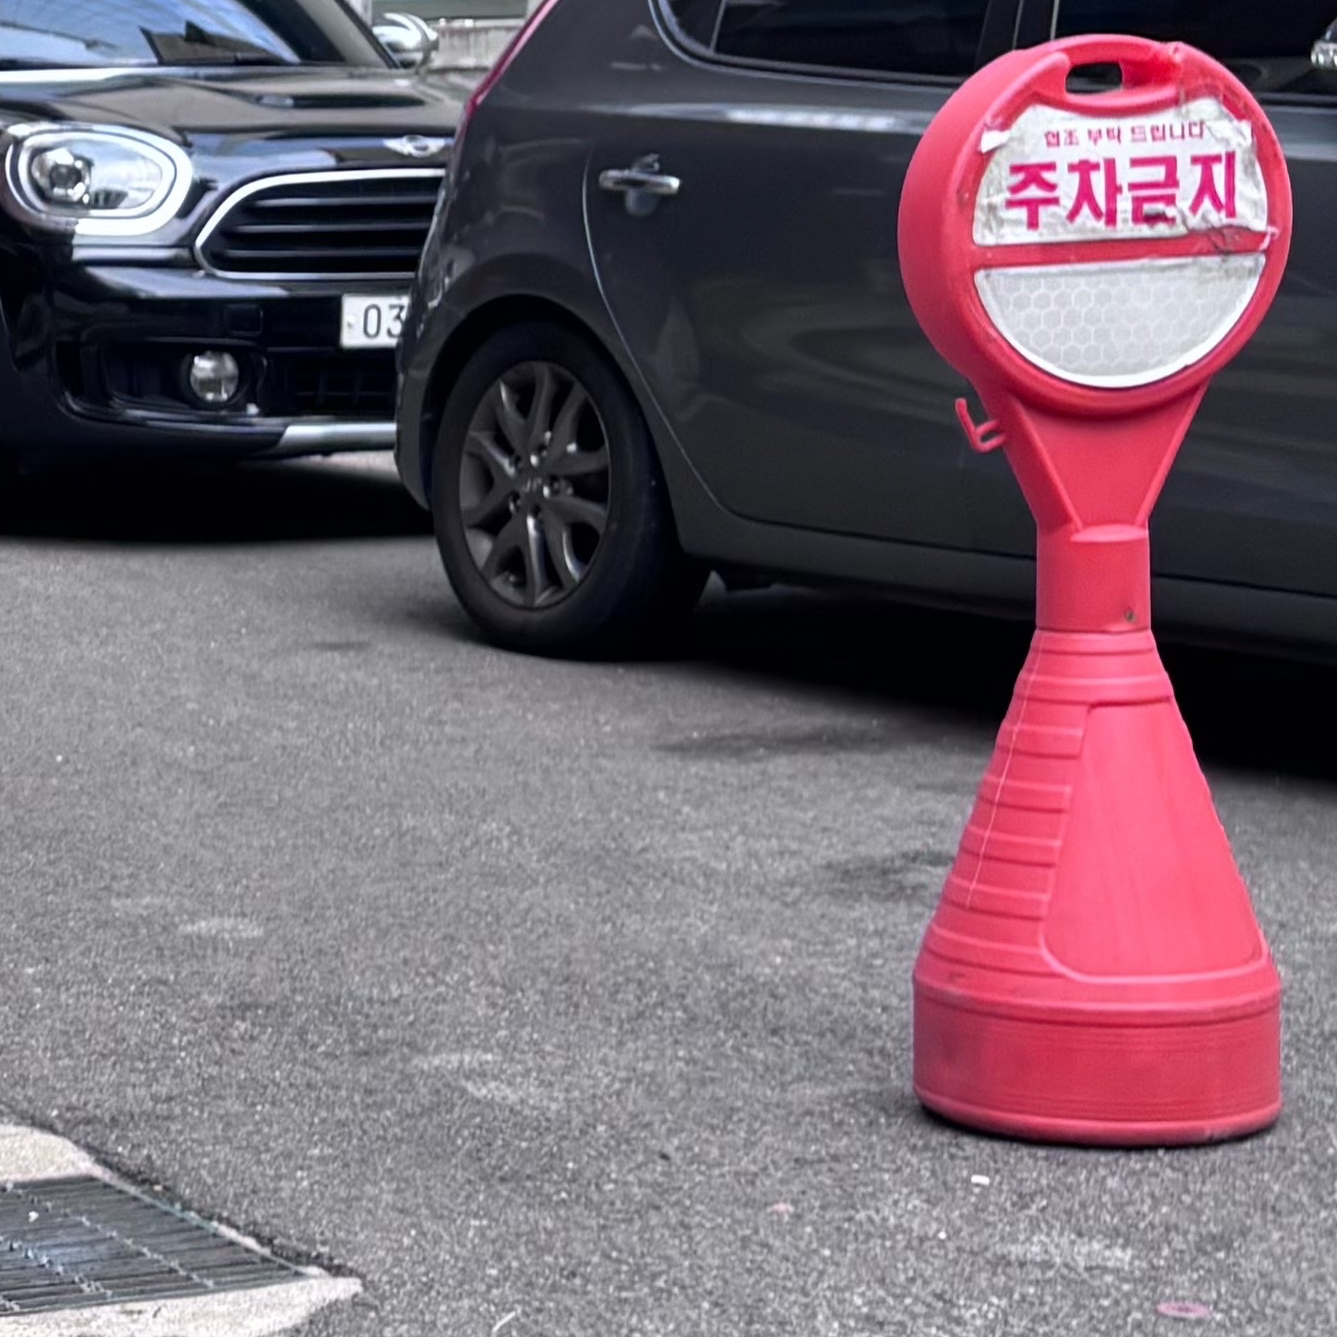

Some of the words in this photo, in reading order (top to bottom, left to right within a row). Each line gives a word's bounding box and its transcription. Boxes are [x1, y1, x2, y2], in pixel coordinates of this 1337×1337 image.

[1087, 125, 1122, 146] 부탁
[1130, 118, 1205, 143] 드립니다
[1004, 150, 1238, 231] 주차금지
